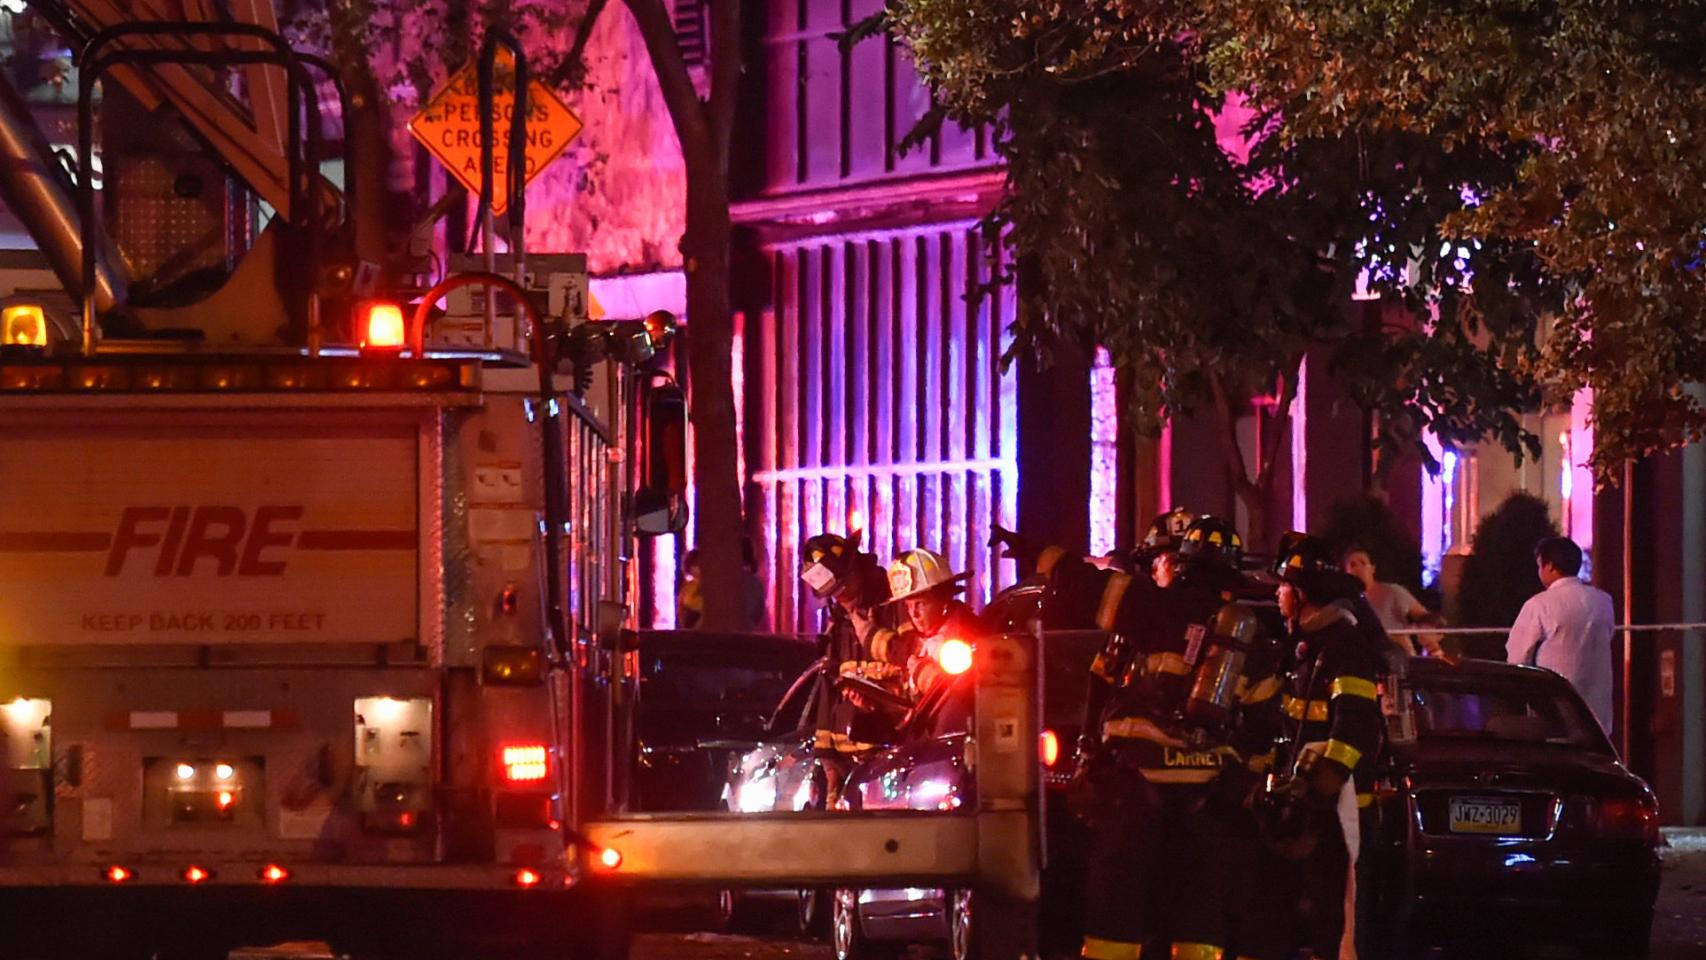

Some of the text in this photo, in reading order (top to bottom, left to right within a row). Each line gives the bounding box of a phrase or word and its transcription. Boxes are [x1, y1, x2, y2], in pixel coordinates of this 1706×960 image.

[445, 102, 549, 122] PESOS
[442, 129, 552, 148] CROSSNG
[463, 156, 536, 174] AED
[104, 505, 305, 578] FIRE
[81, 613, 328, 632] KEEP BACK 200 FEET
